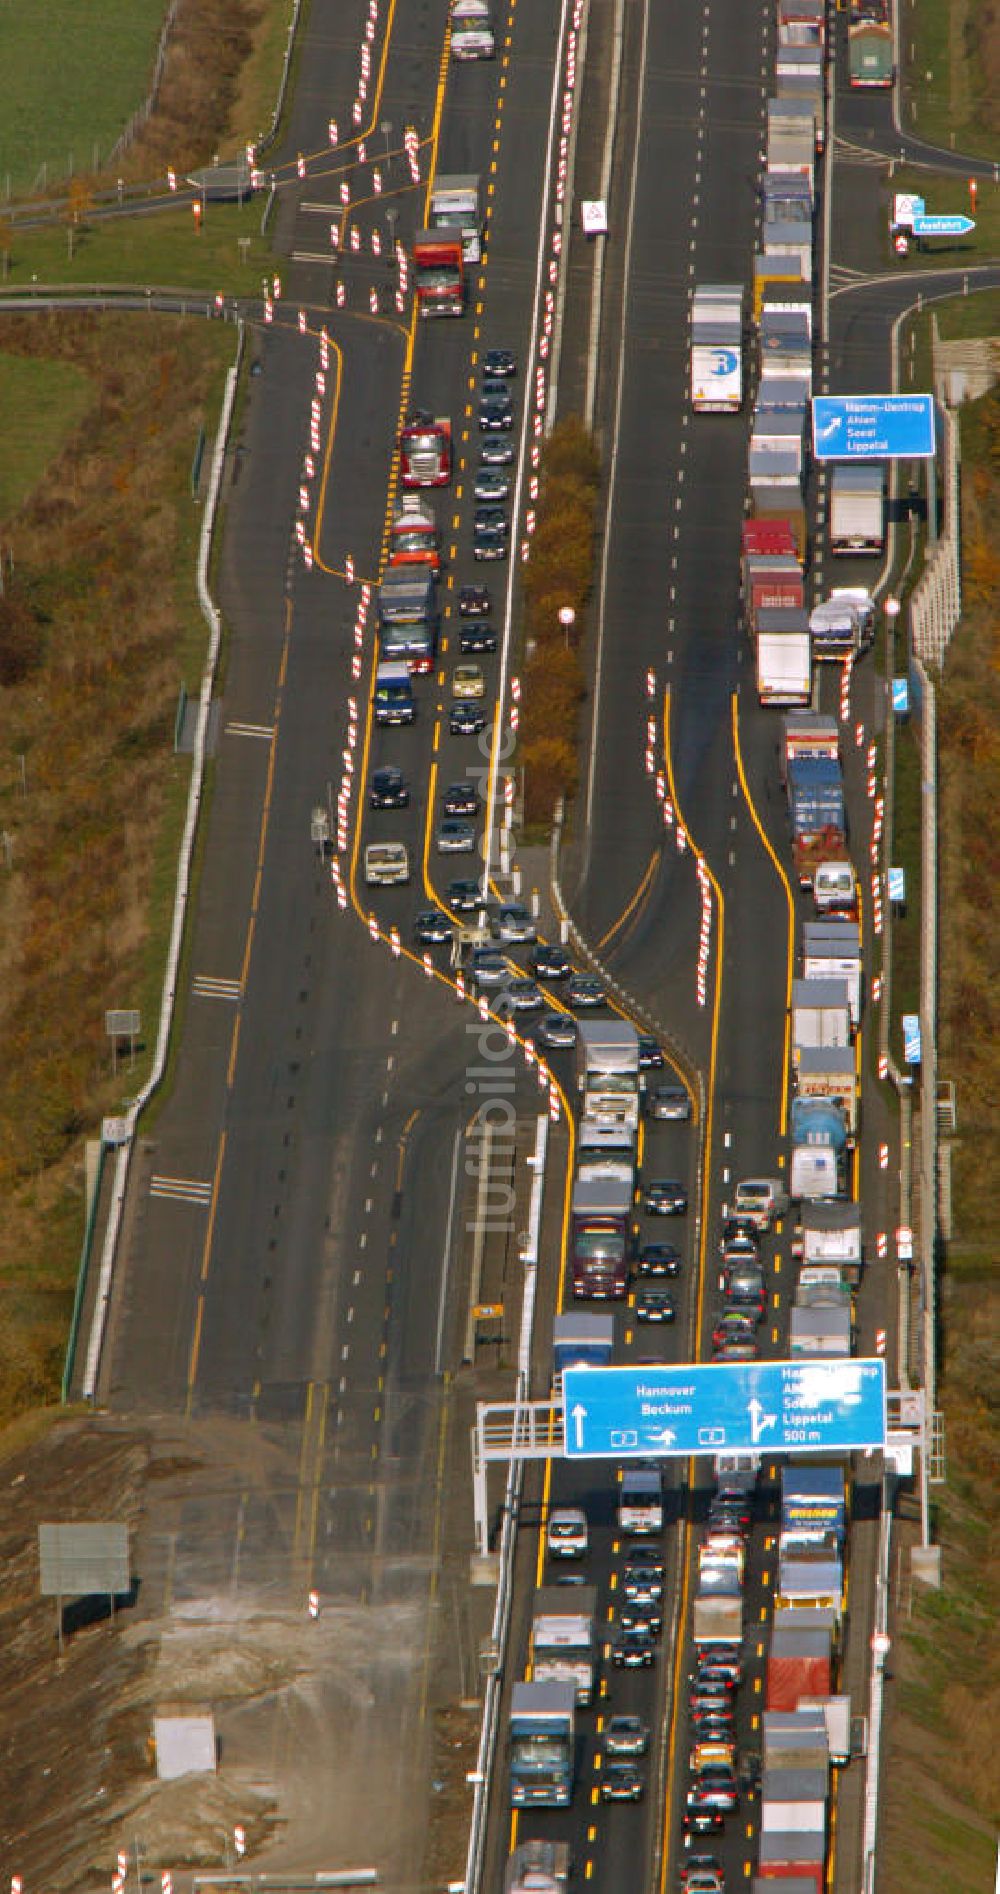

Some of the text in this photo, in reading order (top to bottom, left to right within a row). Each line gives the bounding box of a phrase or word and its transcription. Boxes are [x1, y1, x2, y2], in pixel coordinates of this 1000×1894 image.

[919, 221, 962, 231] Ausfahrt
[847, 440, 888, 452] Lippetal
[636, 1385, 696, 1397] Hannover
[641, 1403, 692, 1416] Beckum
[782, 1411, 833, 1427] Lippetal
[784, 1429, 821, 1442] 500 m
